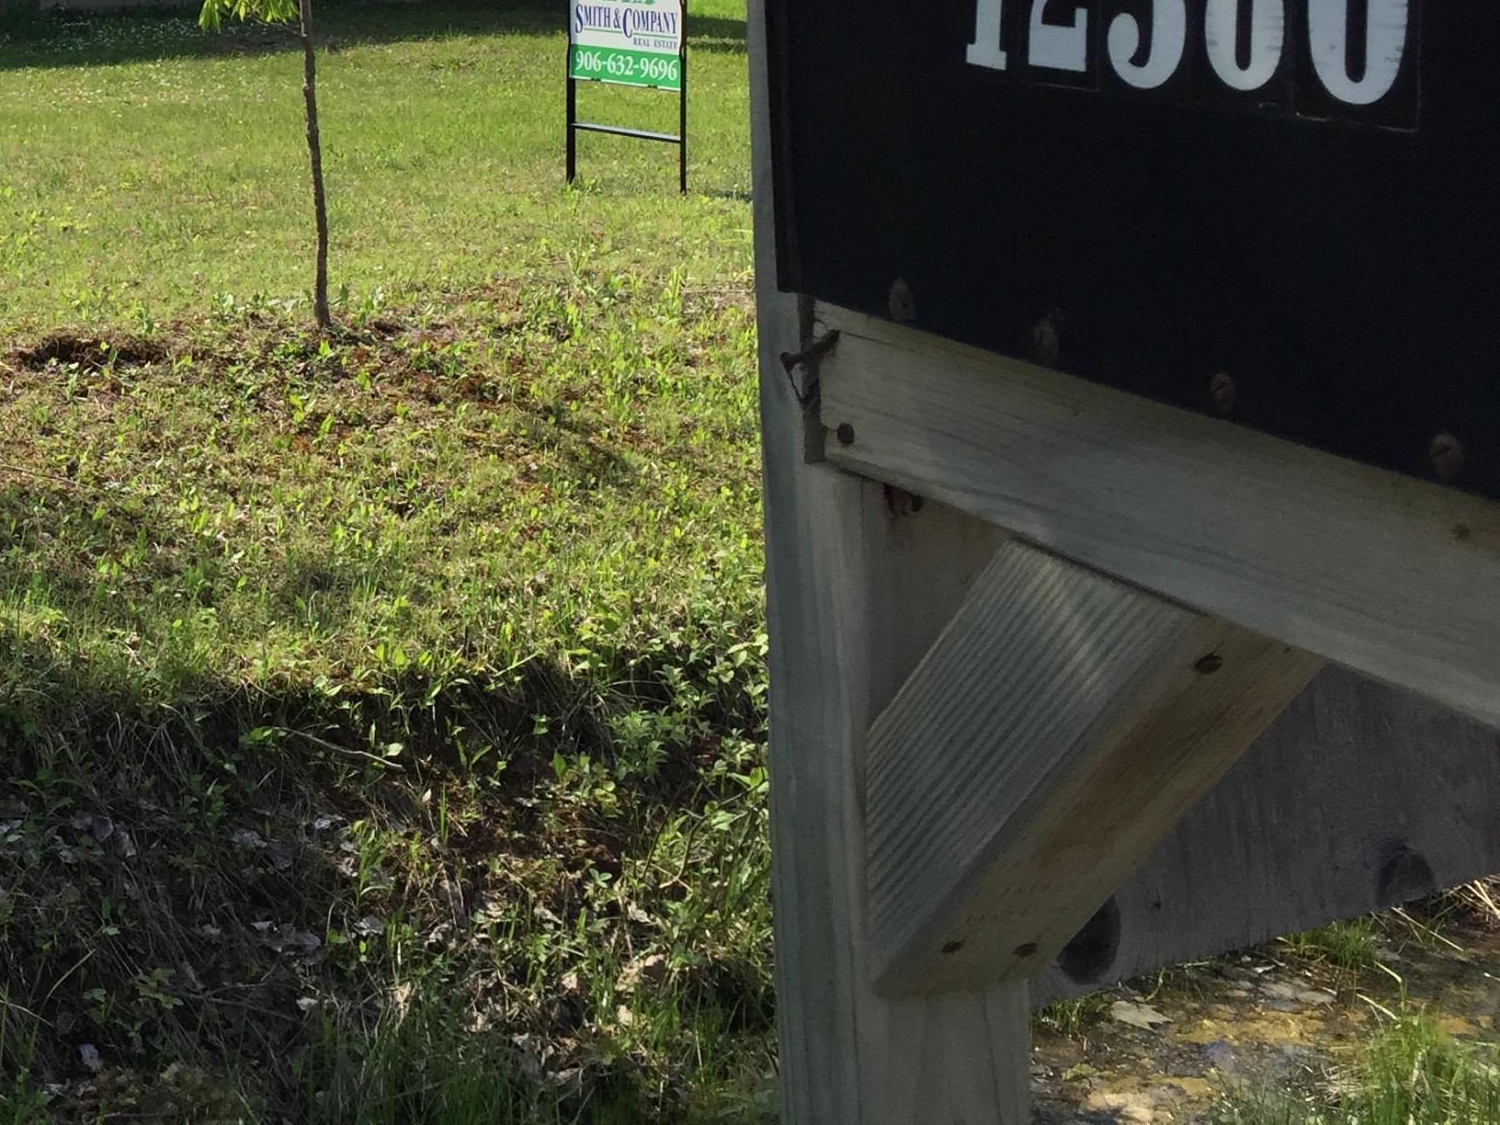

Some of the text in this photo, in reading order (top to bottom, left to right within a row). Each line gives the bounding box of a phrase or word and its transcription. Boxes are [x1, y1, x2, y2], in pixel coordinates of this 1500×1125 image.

[575, 4, 677, 38] SMITH & COMPANY
[633, 38, 651, 48] REAL
[575, 50, 678, 81] 906-632-9696
